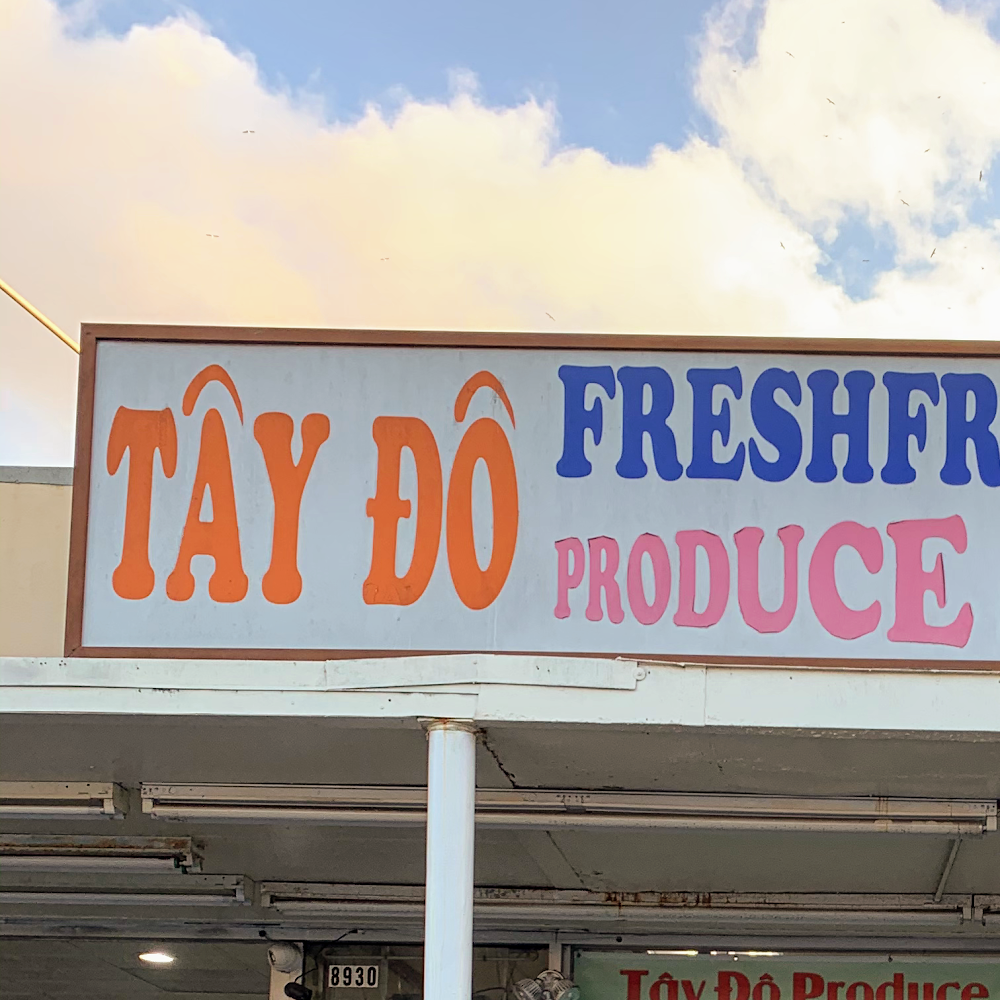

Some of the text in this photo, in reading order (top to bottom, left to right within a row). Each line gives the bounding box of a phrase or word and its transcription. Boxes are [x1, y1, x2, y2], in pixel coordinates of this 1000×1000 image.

[107, 365, 519, 610] TÂY ĐÔ
[554, 515, 974, 648] PRODUCE
[330, 966, 377, 988] 8930
